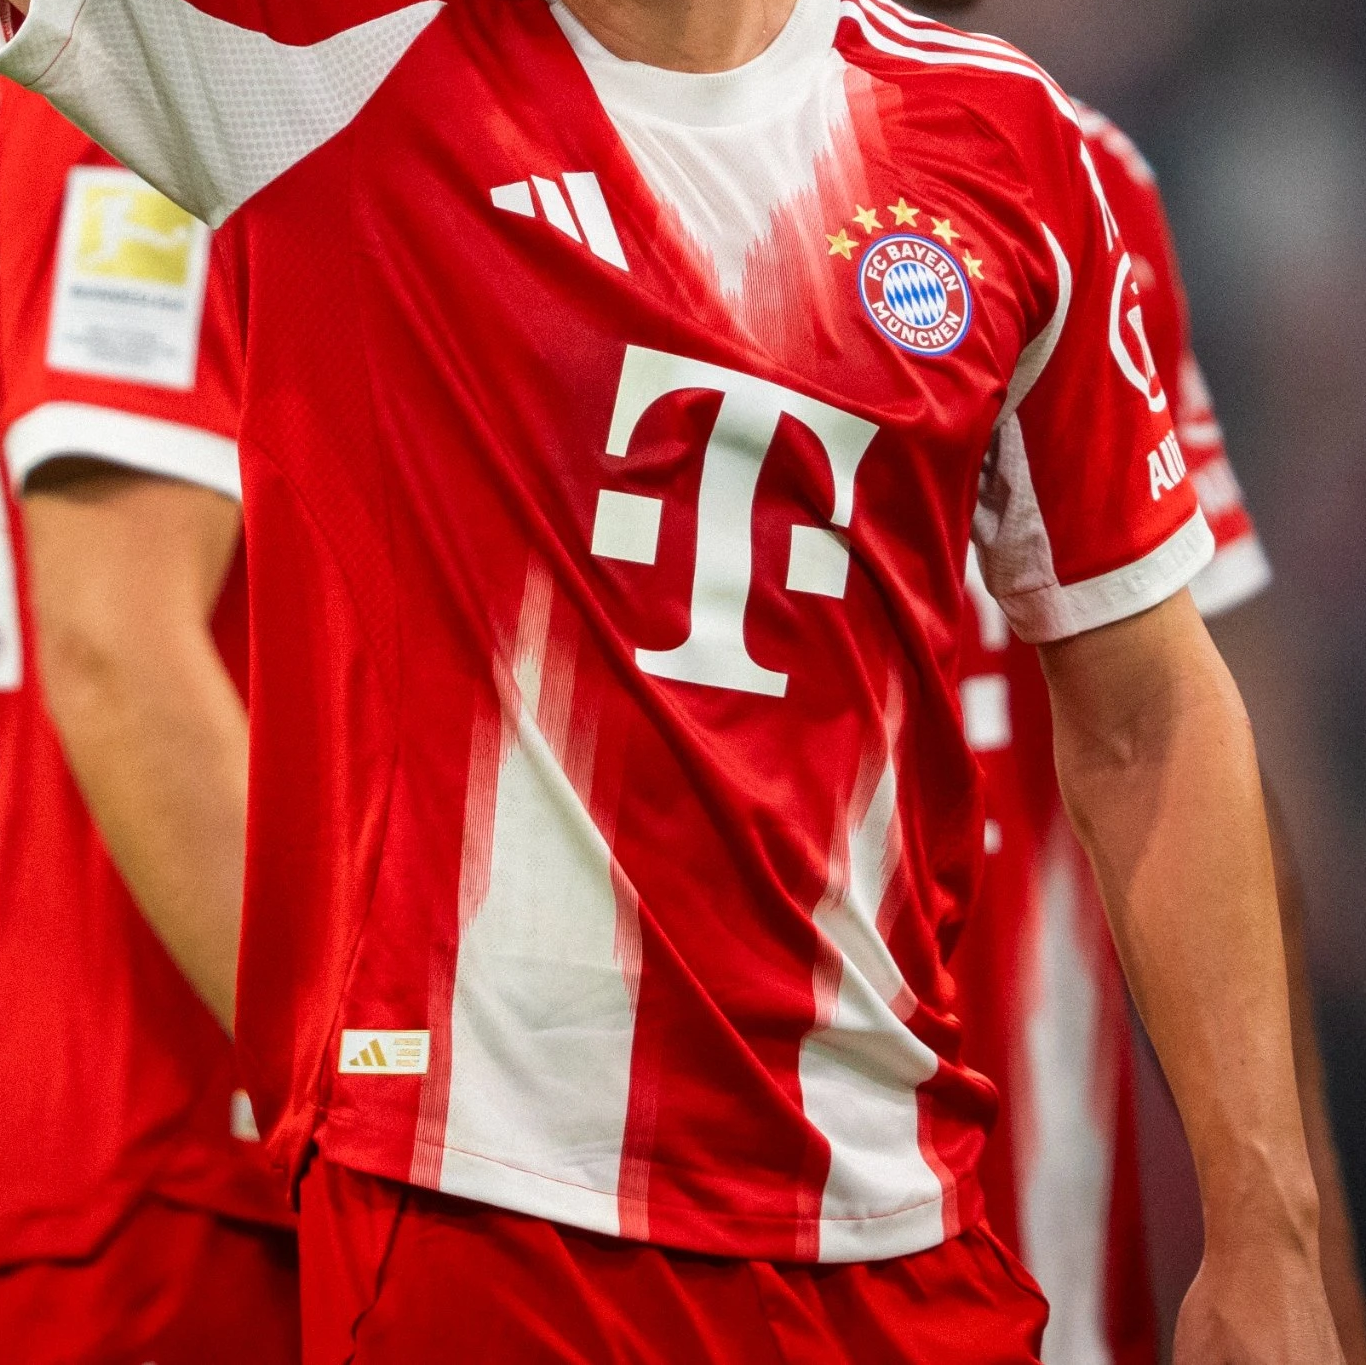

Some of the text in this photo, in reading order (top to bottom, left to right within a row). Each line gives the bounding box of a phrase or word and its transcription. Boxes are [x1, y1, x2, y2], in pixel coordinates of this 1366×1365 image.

[866, 242, 960, 292] FC BAYERN
[871, 300, 962, 347] MÜNCHEN
[604, 343, 880, 698] T
